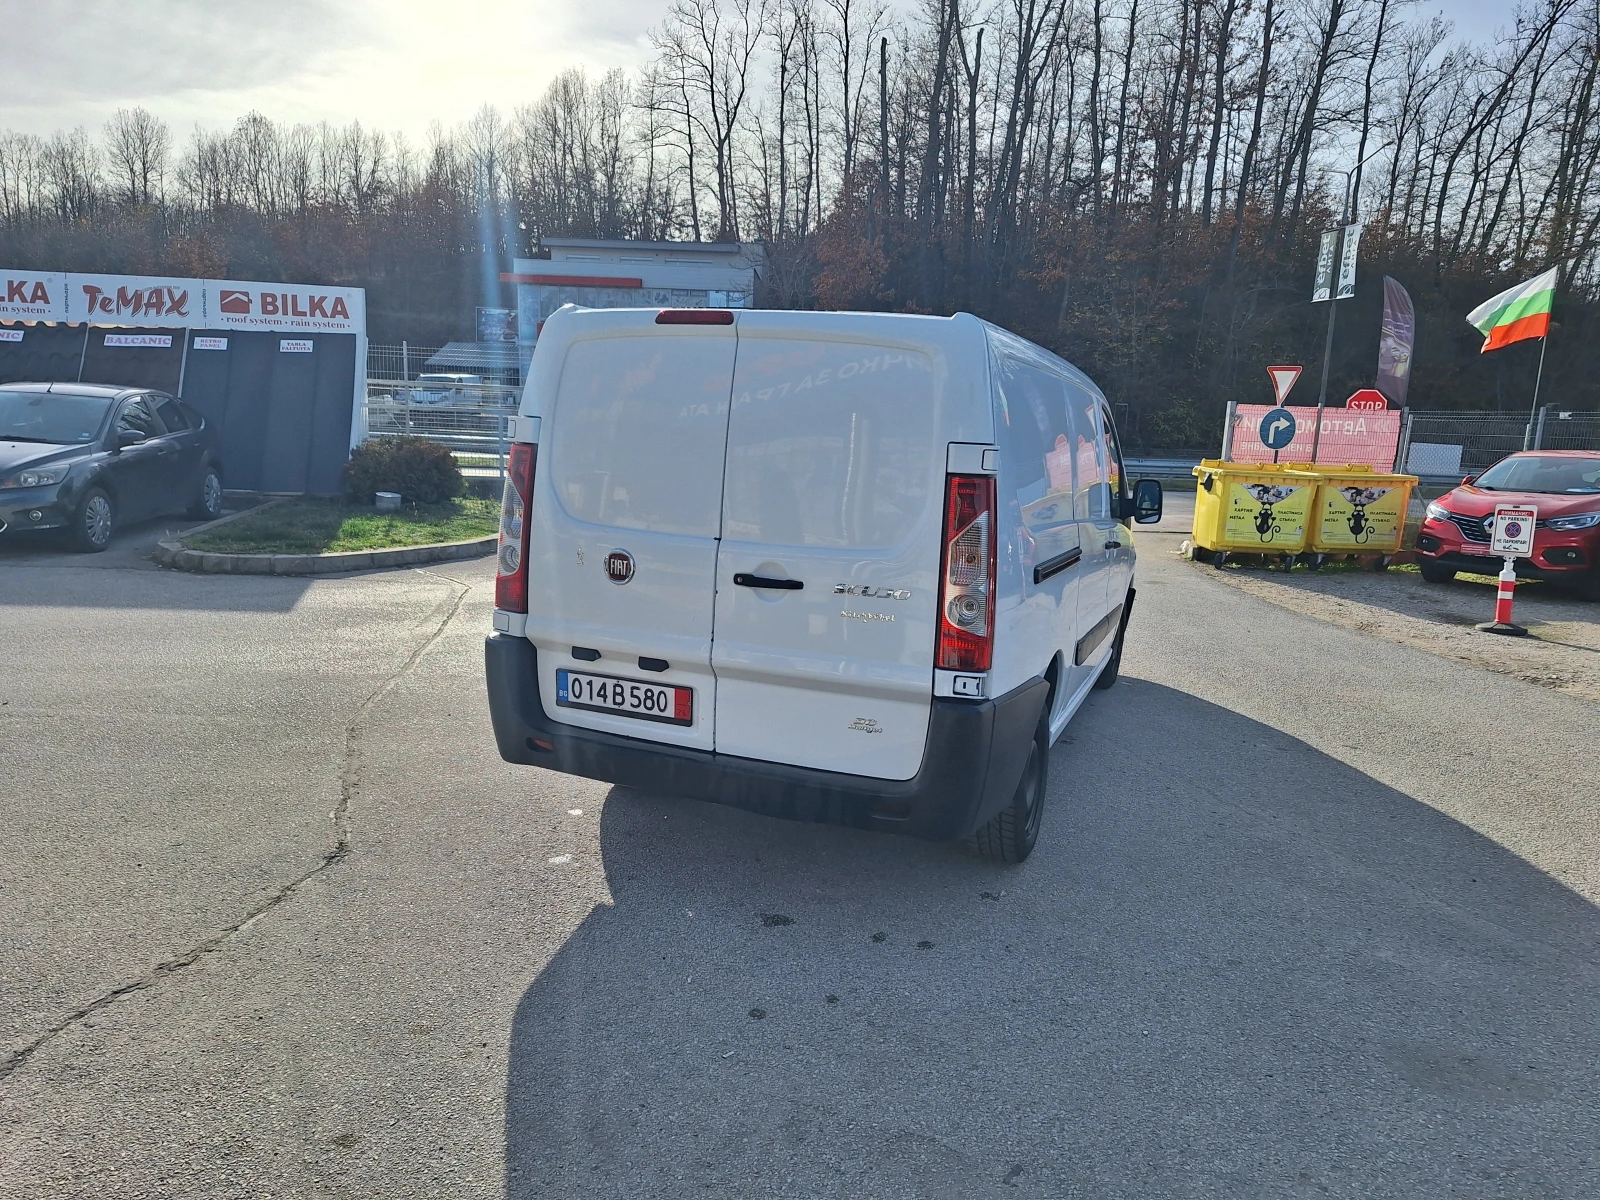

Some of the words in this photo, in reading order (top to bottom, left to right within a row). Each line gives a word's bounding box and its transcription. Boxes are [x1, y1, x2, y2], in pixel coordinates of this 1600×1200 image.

[1317, 234, 1331, 285] efbet
[1341, 228, 1355, 280] efbet
[11, 306, 46, 314] system
[260, 292, 350, 320] BILKA
[226, 315, 248, 323] roof
[249, 317, 282, 326] system
[291, 319, 311, 327] rain
[312, 321, 346, 329] system
[105, 336, 171, 345] BALCANIC
[610, 558, 628, 576] FIAT
[832, 583, 912, 601] SCUDO
[559, 689, 568, 697] BG
[571, 677, 668, 713] 014B580
